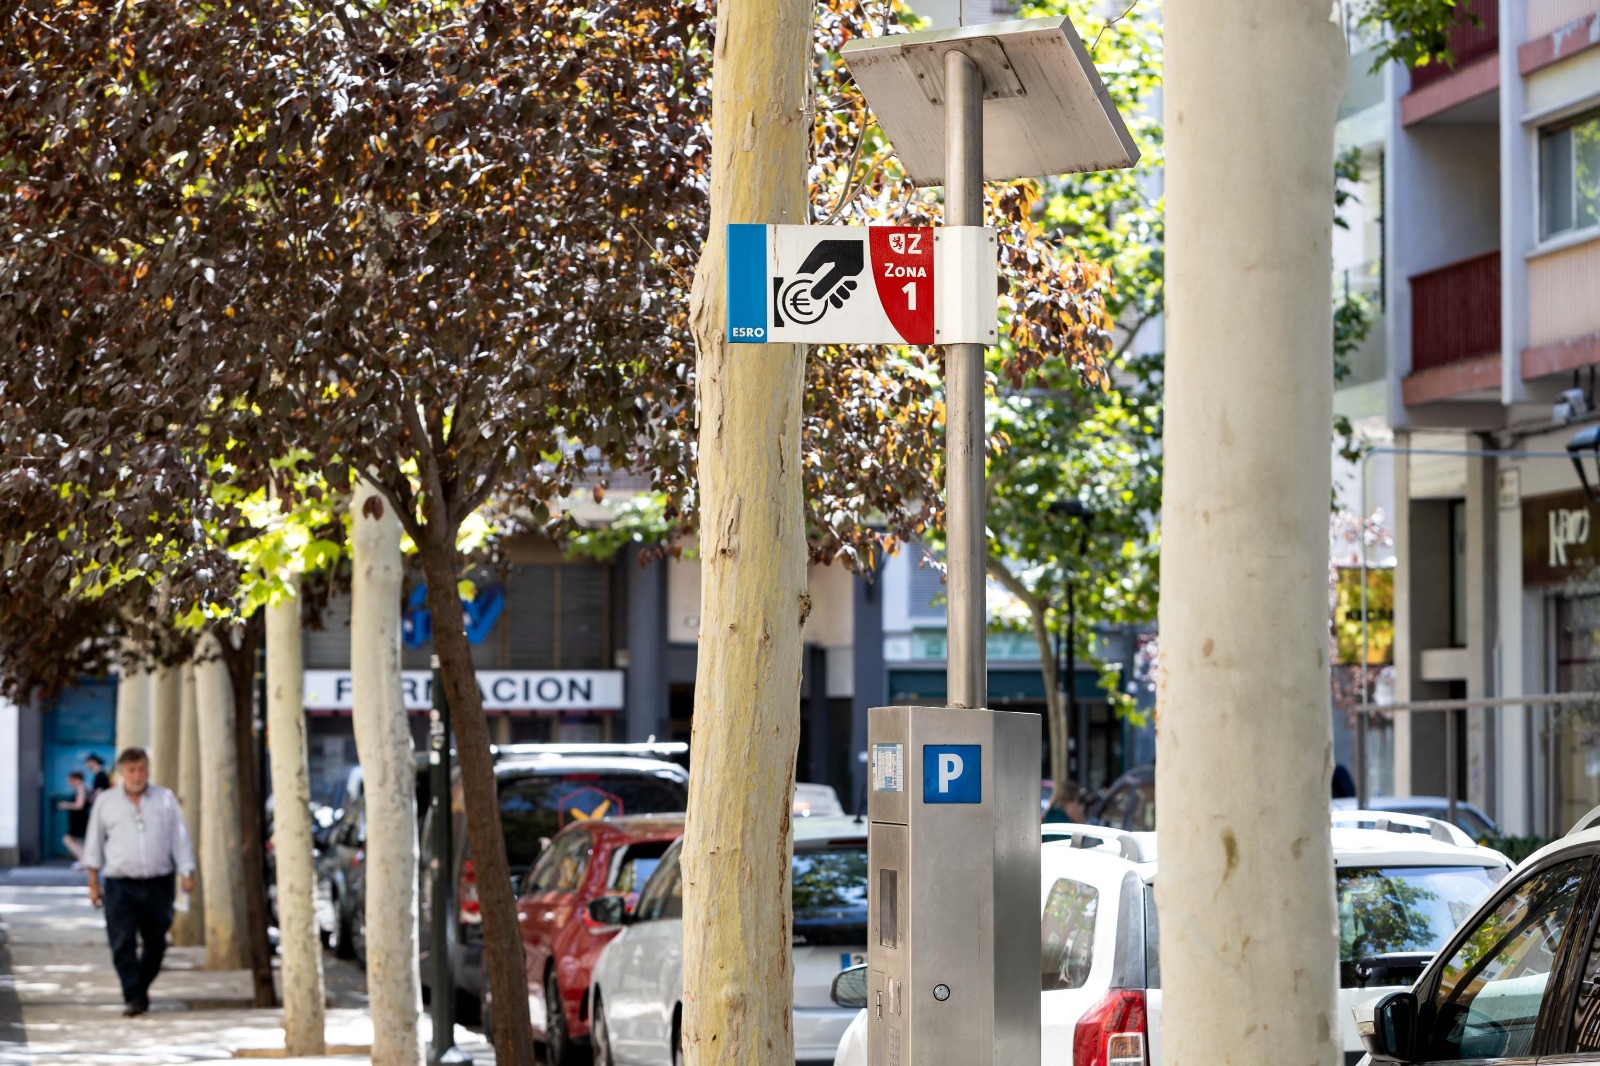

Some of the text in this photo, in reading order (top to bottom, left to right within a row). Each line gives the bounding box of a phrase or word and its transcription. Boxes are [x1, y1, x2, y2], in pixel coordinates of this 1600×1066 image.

[907, 233, 922, 254] Z
[884, 262, 927, 278] ZONA
[902, 281, 917, 311] 1
[732, 327, 765, 338] ESRO
[335, 678, 592, 701] FRCION
[938, 753, 964, 793] P
